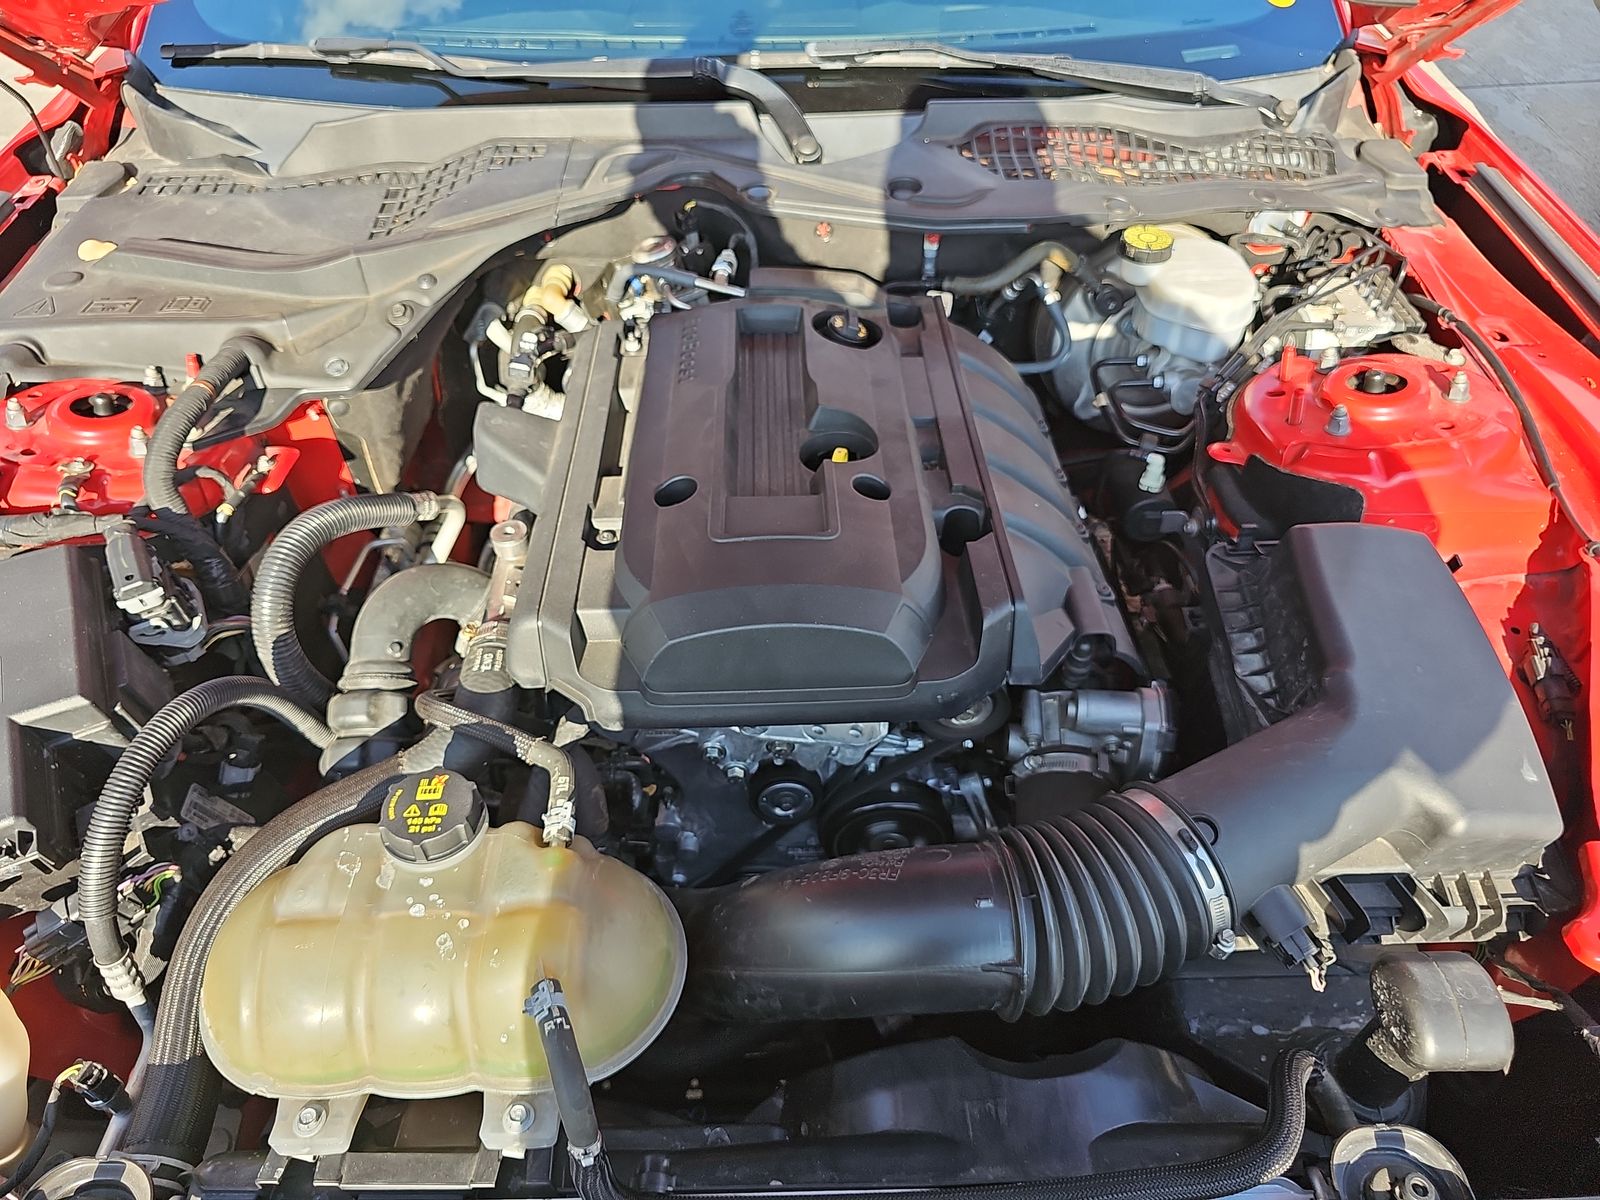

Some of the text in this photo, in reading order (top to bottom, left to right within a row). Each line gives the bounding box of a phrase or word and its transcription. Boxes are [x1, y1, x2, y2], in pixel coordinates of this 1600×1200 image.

[408, 824, 436, 834] 21 psi
[544, 1016, 571, 1037] RTL
